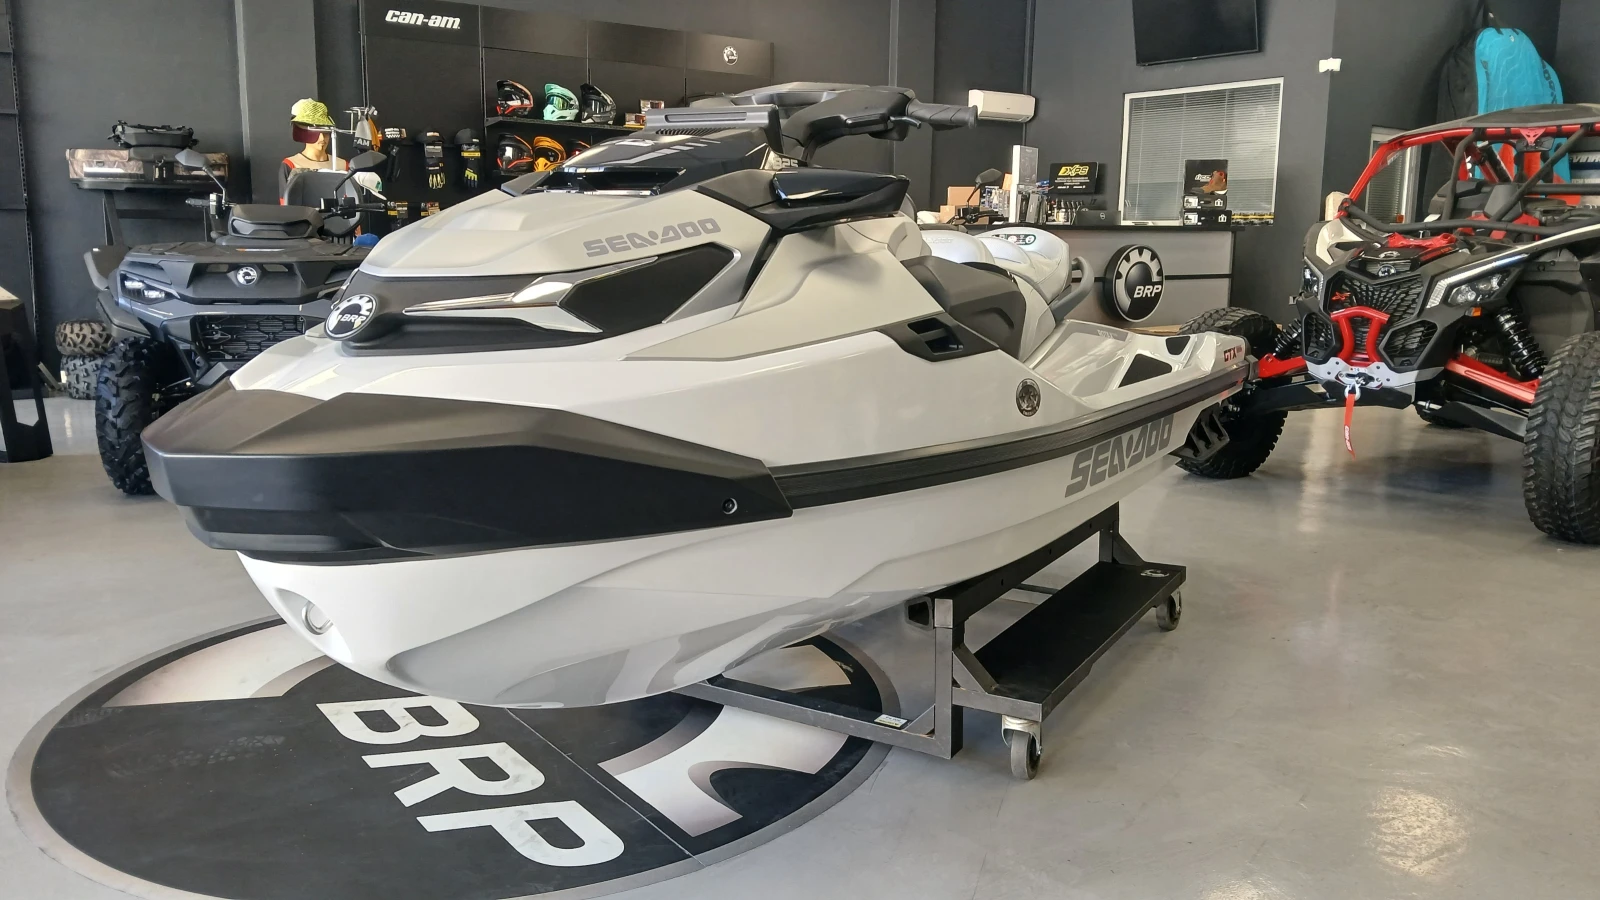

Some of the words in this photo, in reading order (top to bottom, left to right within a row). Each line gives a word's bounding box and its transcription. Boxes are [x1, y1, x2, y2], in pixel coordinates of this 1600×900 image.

[1134, 284, 1162, 298] BRP
[340, 313, 367, 323] BRP
[316, 695, 625, 867] BRP
